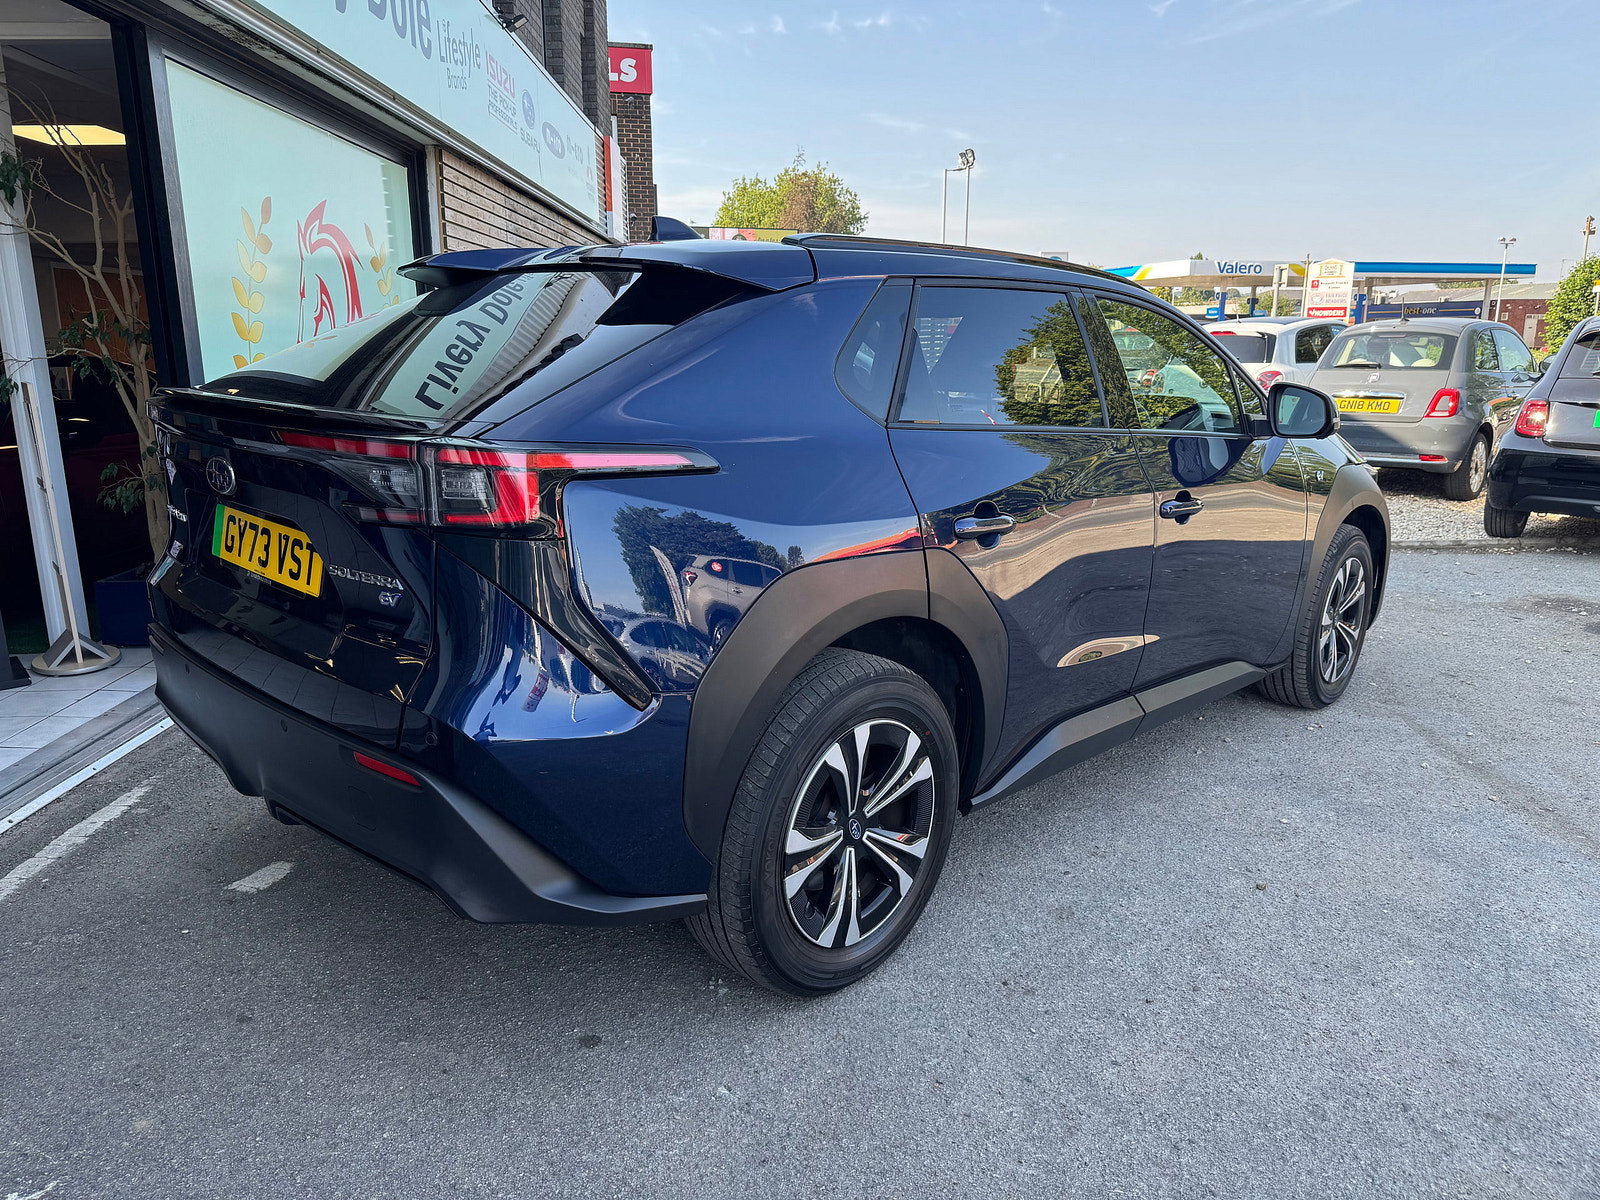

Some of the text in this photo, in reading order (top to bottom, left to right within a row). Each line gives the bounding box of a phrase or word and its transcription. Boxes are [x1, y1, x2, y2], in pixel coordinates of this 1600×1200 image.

[436, 18, 481, 78] Lifestyle
[446, 67, 468, 90] Brands
[486, 51, 516, 98] ISUZU
[1217, 261, 1263, 275] Valero
[1339, 400, 1391, 411] GN18 KMO
[224, 514, 318, 586] GY73 VST
[329, 564, 404, 591] SOLTERRA
[378, 591, 402, 607] EV
